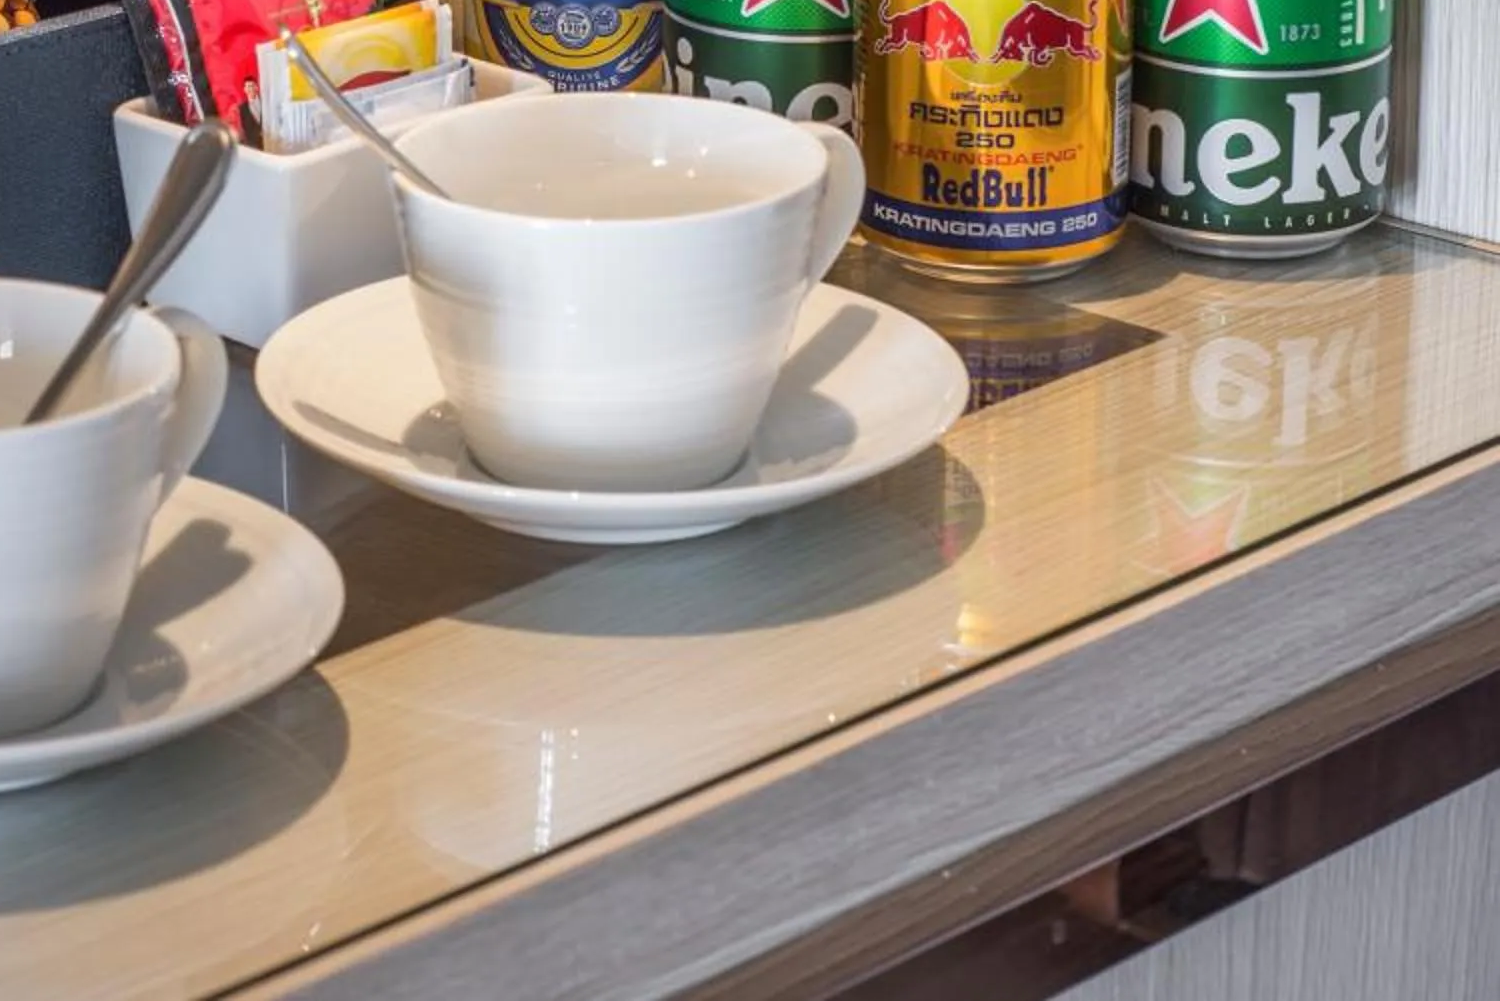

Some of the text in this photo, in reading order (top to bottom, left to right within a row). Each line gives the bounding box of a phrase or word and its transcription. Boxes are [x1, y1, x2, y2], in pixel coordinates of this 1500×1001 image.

[1279, 24, 1321, 42] 1873
[955, 131, 1016, 149] 250
[1130, 91, 1390, 206] neke
[893, 143, 1077, 167] KRATINGDAENG
[873, 202, 1099, 238] KRATINGDAENG 250
